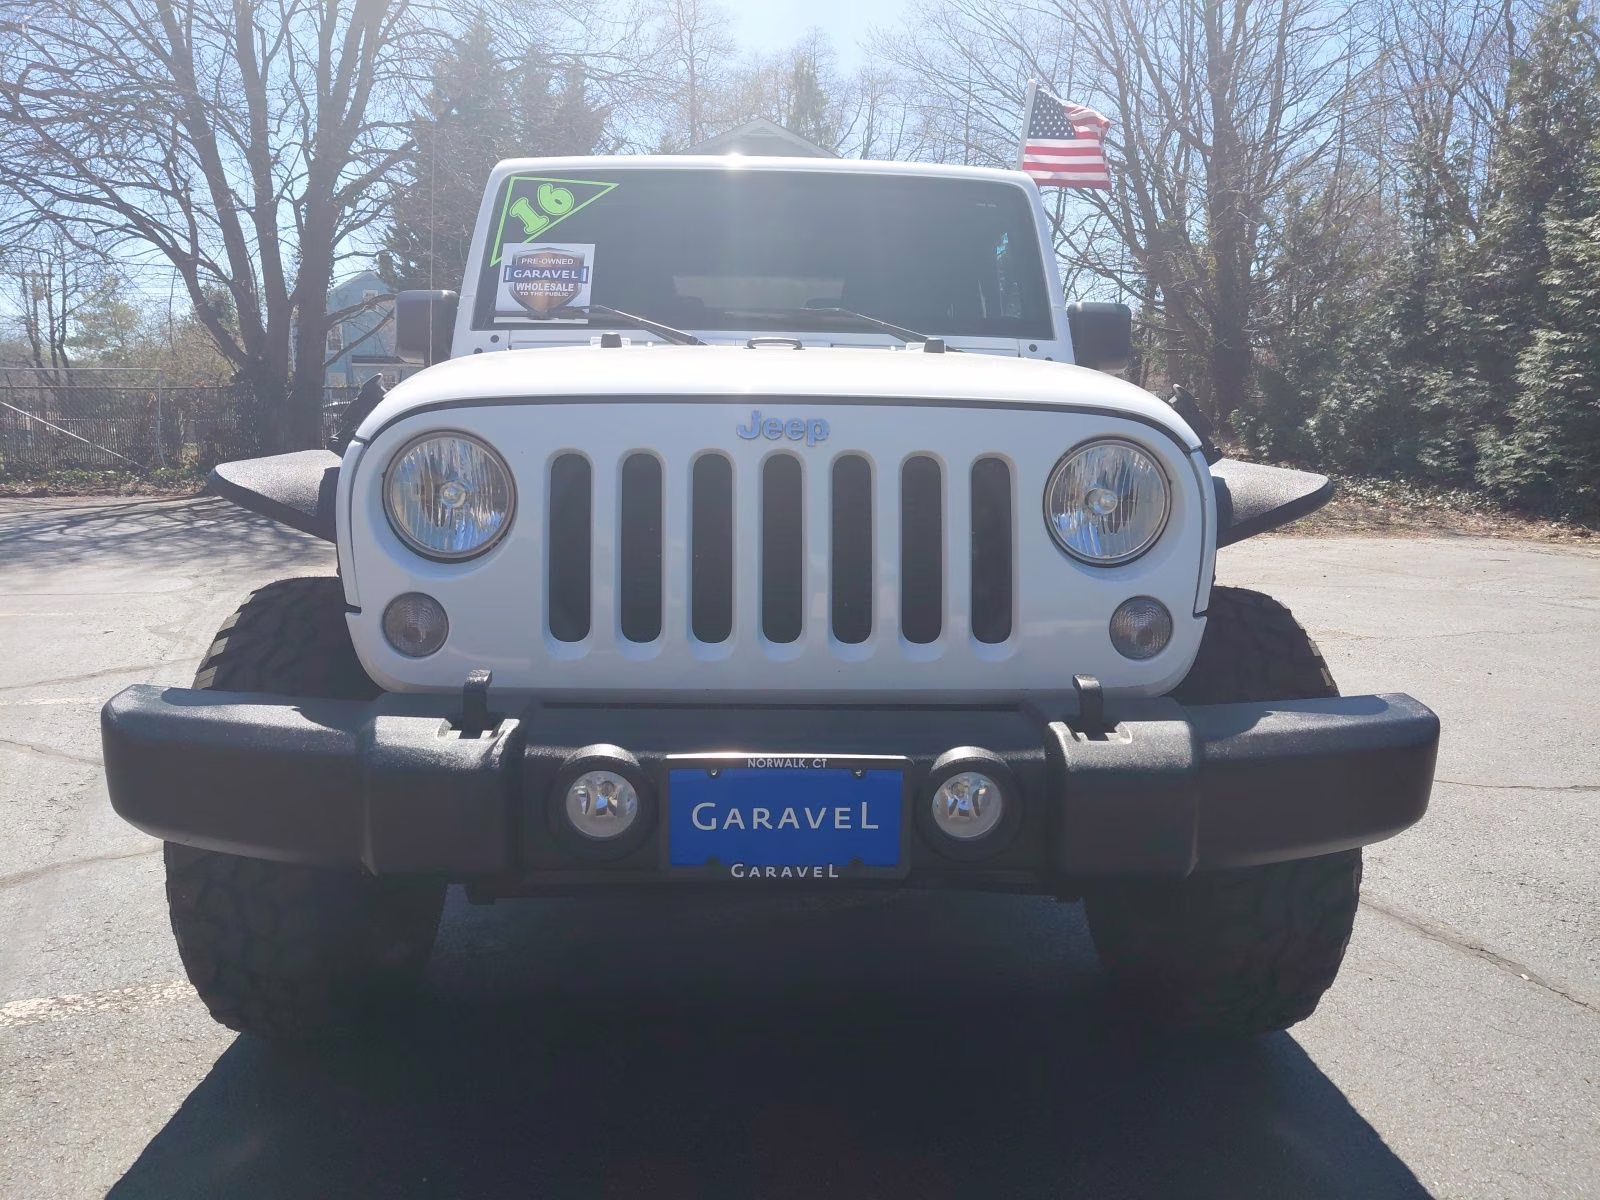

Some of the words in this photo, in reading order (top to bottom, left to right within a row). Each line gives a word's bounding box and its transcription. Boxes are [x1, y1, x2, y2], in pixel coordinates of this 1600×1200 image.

[509, 183, 575, 234] 16
[521, 257, 574, 265] PRE-OWNED
[513, 269, 578, 279] GARAVEL
[516, 282, 574, 292] WHOLESALE
[736, 409, 830, 447] Jeep
[747, 758, 809, 769] NORWALK,
[812, 758, 827, 769] CT
[691, 801, 879, 831] GARAVEL
[730, 863, 839, 878] GARAVEL
